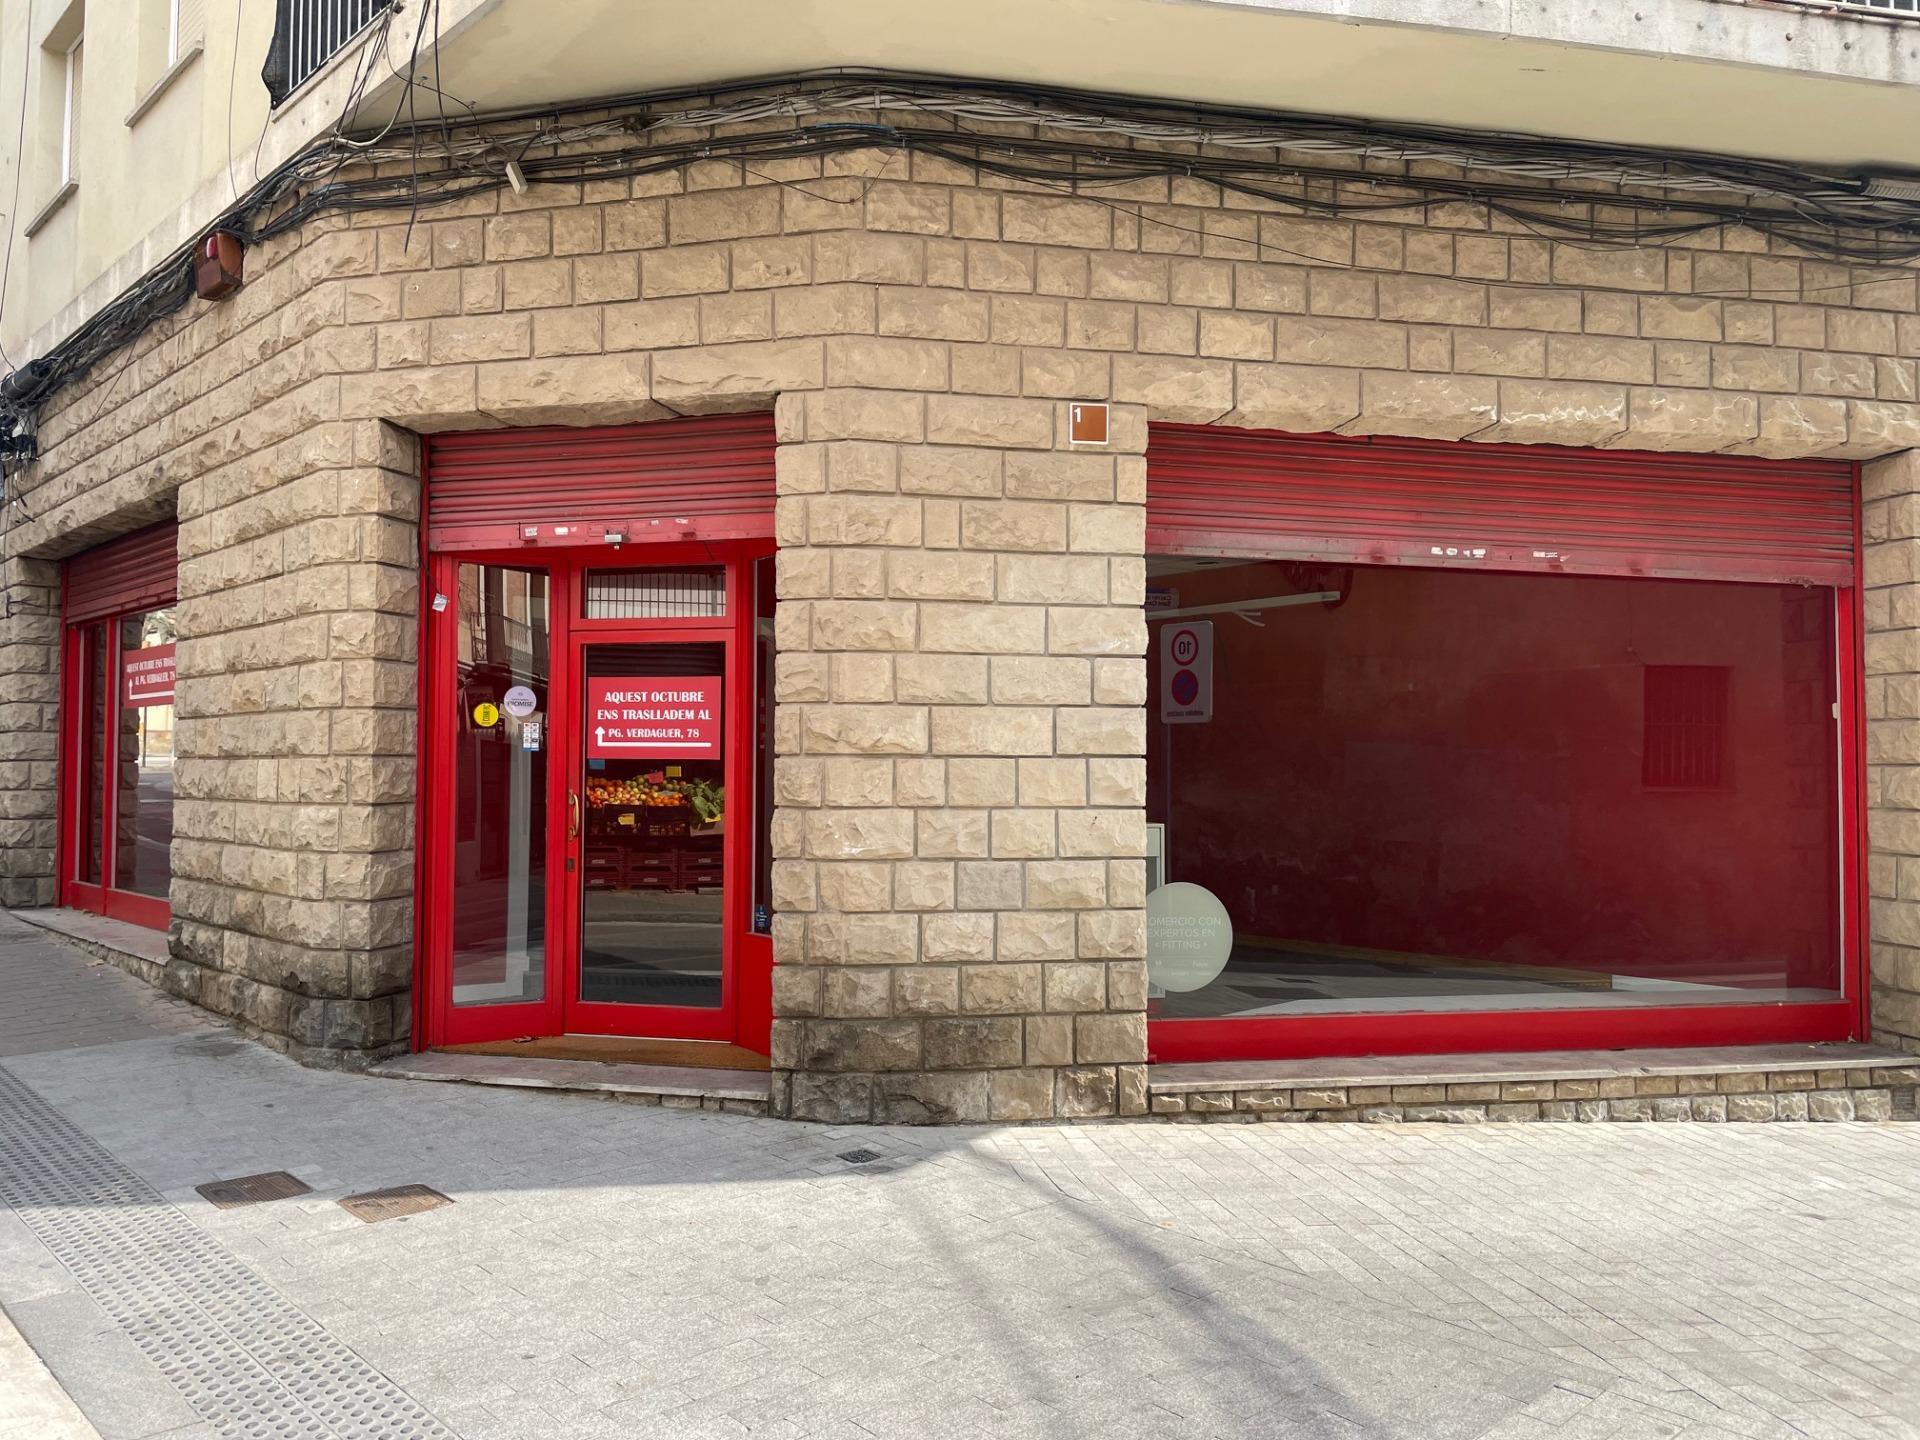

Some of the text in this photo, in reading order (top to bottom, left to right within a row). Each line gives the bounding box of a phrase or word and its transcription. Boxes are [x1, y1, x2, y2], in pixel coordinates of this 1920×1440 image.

[1074, 407, 1081, 423] 1
[604, 691, 704, 704] AQUEST OCTUBRE
[597, 709, 712, 720] ENS TRASLLADEM AL
[608, 728, 700, 739] PG. VERDAGUER, 78
[1148, 917, 1222, 926] OMERCIO CON
[1147, 928, 1216, 937] EXPERTOS EN
[1162, 940, 1201, 950] FITTING
